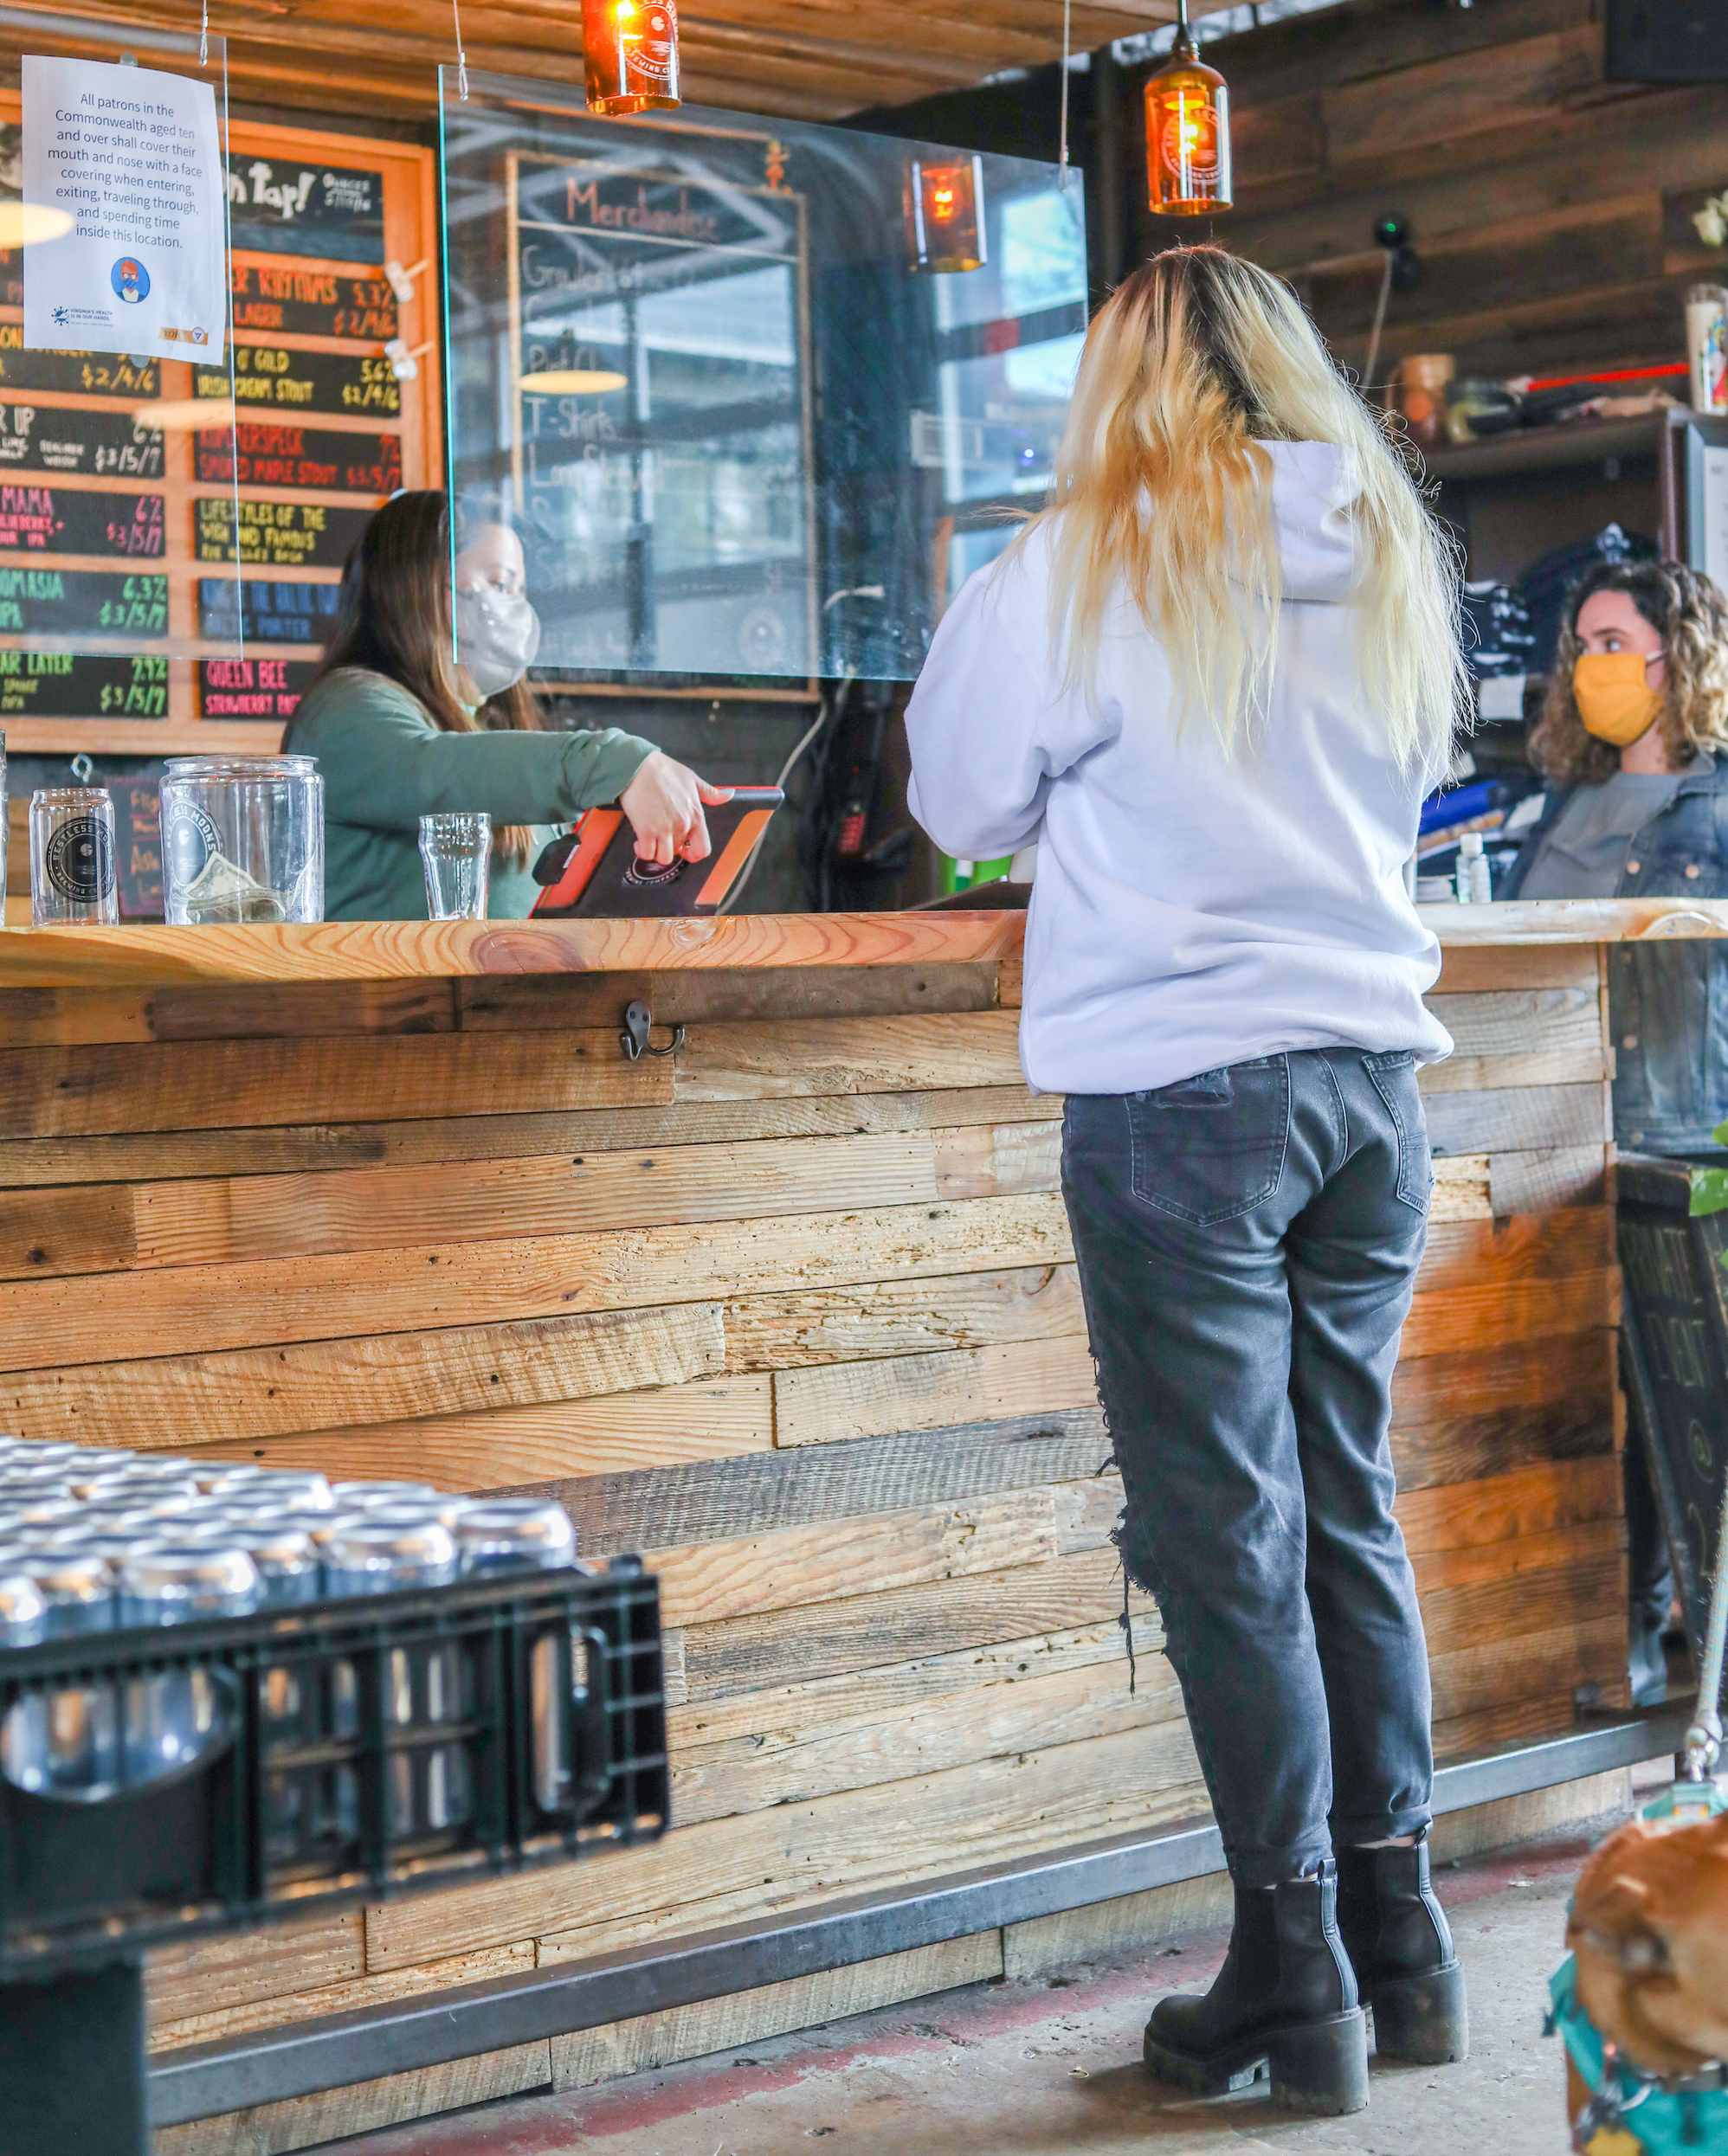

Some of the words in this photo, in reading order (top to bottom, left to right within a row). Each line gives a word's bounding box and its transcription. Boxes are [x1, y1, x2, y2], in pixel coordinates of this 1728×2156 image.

[81, 93, 94, 106] All
[98, 98, 140, 113] patrons
[143, 101, 153, 114] in
[157, 104, 175, 118] the
[55, 110, 147, 132] Commonwealth
[150, 124, 176, 137] aged
[178, 127, 195, 139] ten
[56, 130, 81, 141] and
[84, 133, 109, 145] over
[112, 135, 137, 149] shall
[140, 140, 170, 153] cover
[172, 144, 196, 158] their
[48, 149, 88, 161] mouth
[92, 152, 113, 164] and
[117, 157, 143, 169] nose
[145, 159, 170, 172] with
[172, 164, 179, 173] a
[181, 163, 203, 177] face
[61, 169, 112, 186] covering
[113, 173, 144, 187] when
[147, 179, 195, 197] entering,
[248, 162, 316, 219] Tap!
[55, 185, 100, 203] exiting,
[103, 190, 150, 210] traveling
[153, 196, 199, 216] through,
[77, 207, 100, 218] and
[102, 209, 152, 229] spending
[154, 216, 180, 229] time
[76, 224, 111, 239] inside
[113, 228, 132, 242] this
[134, 231, 184, 248] location.
[255, 350, 290, 373] GOLD
[14, 406, 35, 436] UP
[95, 444, 162, 474] $3/5/7
[1, 485, 55, 518] MAMA
[135, 495, 162, 524] 6%
[276, 505, 295, 527] OF
[302, 505, 326, 531] THE
[122, 576, 167, 602] 6.3%
[100, 599, 166, 630] $3/5/7
[207, 660, 254, 688] QUEEN
[259, 660, 287, 689] BEE
[100, 682, 166, 716] $3/5/7
[53, 825, 93, 861] RESTLESS
[190, 810, 216, 851] MOONS
